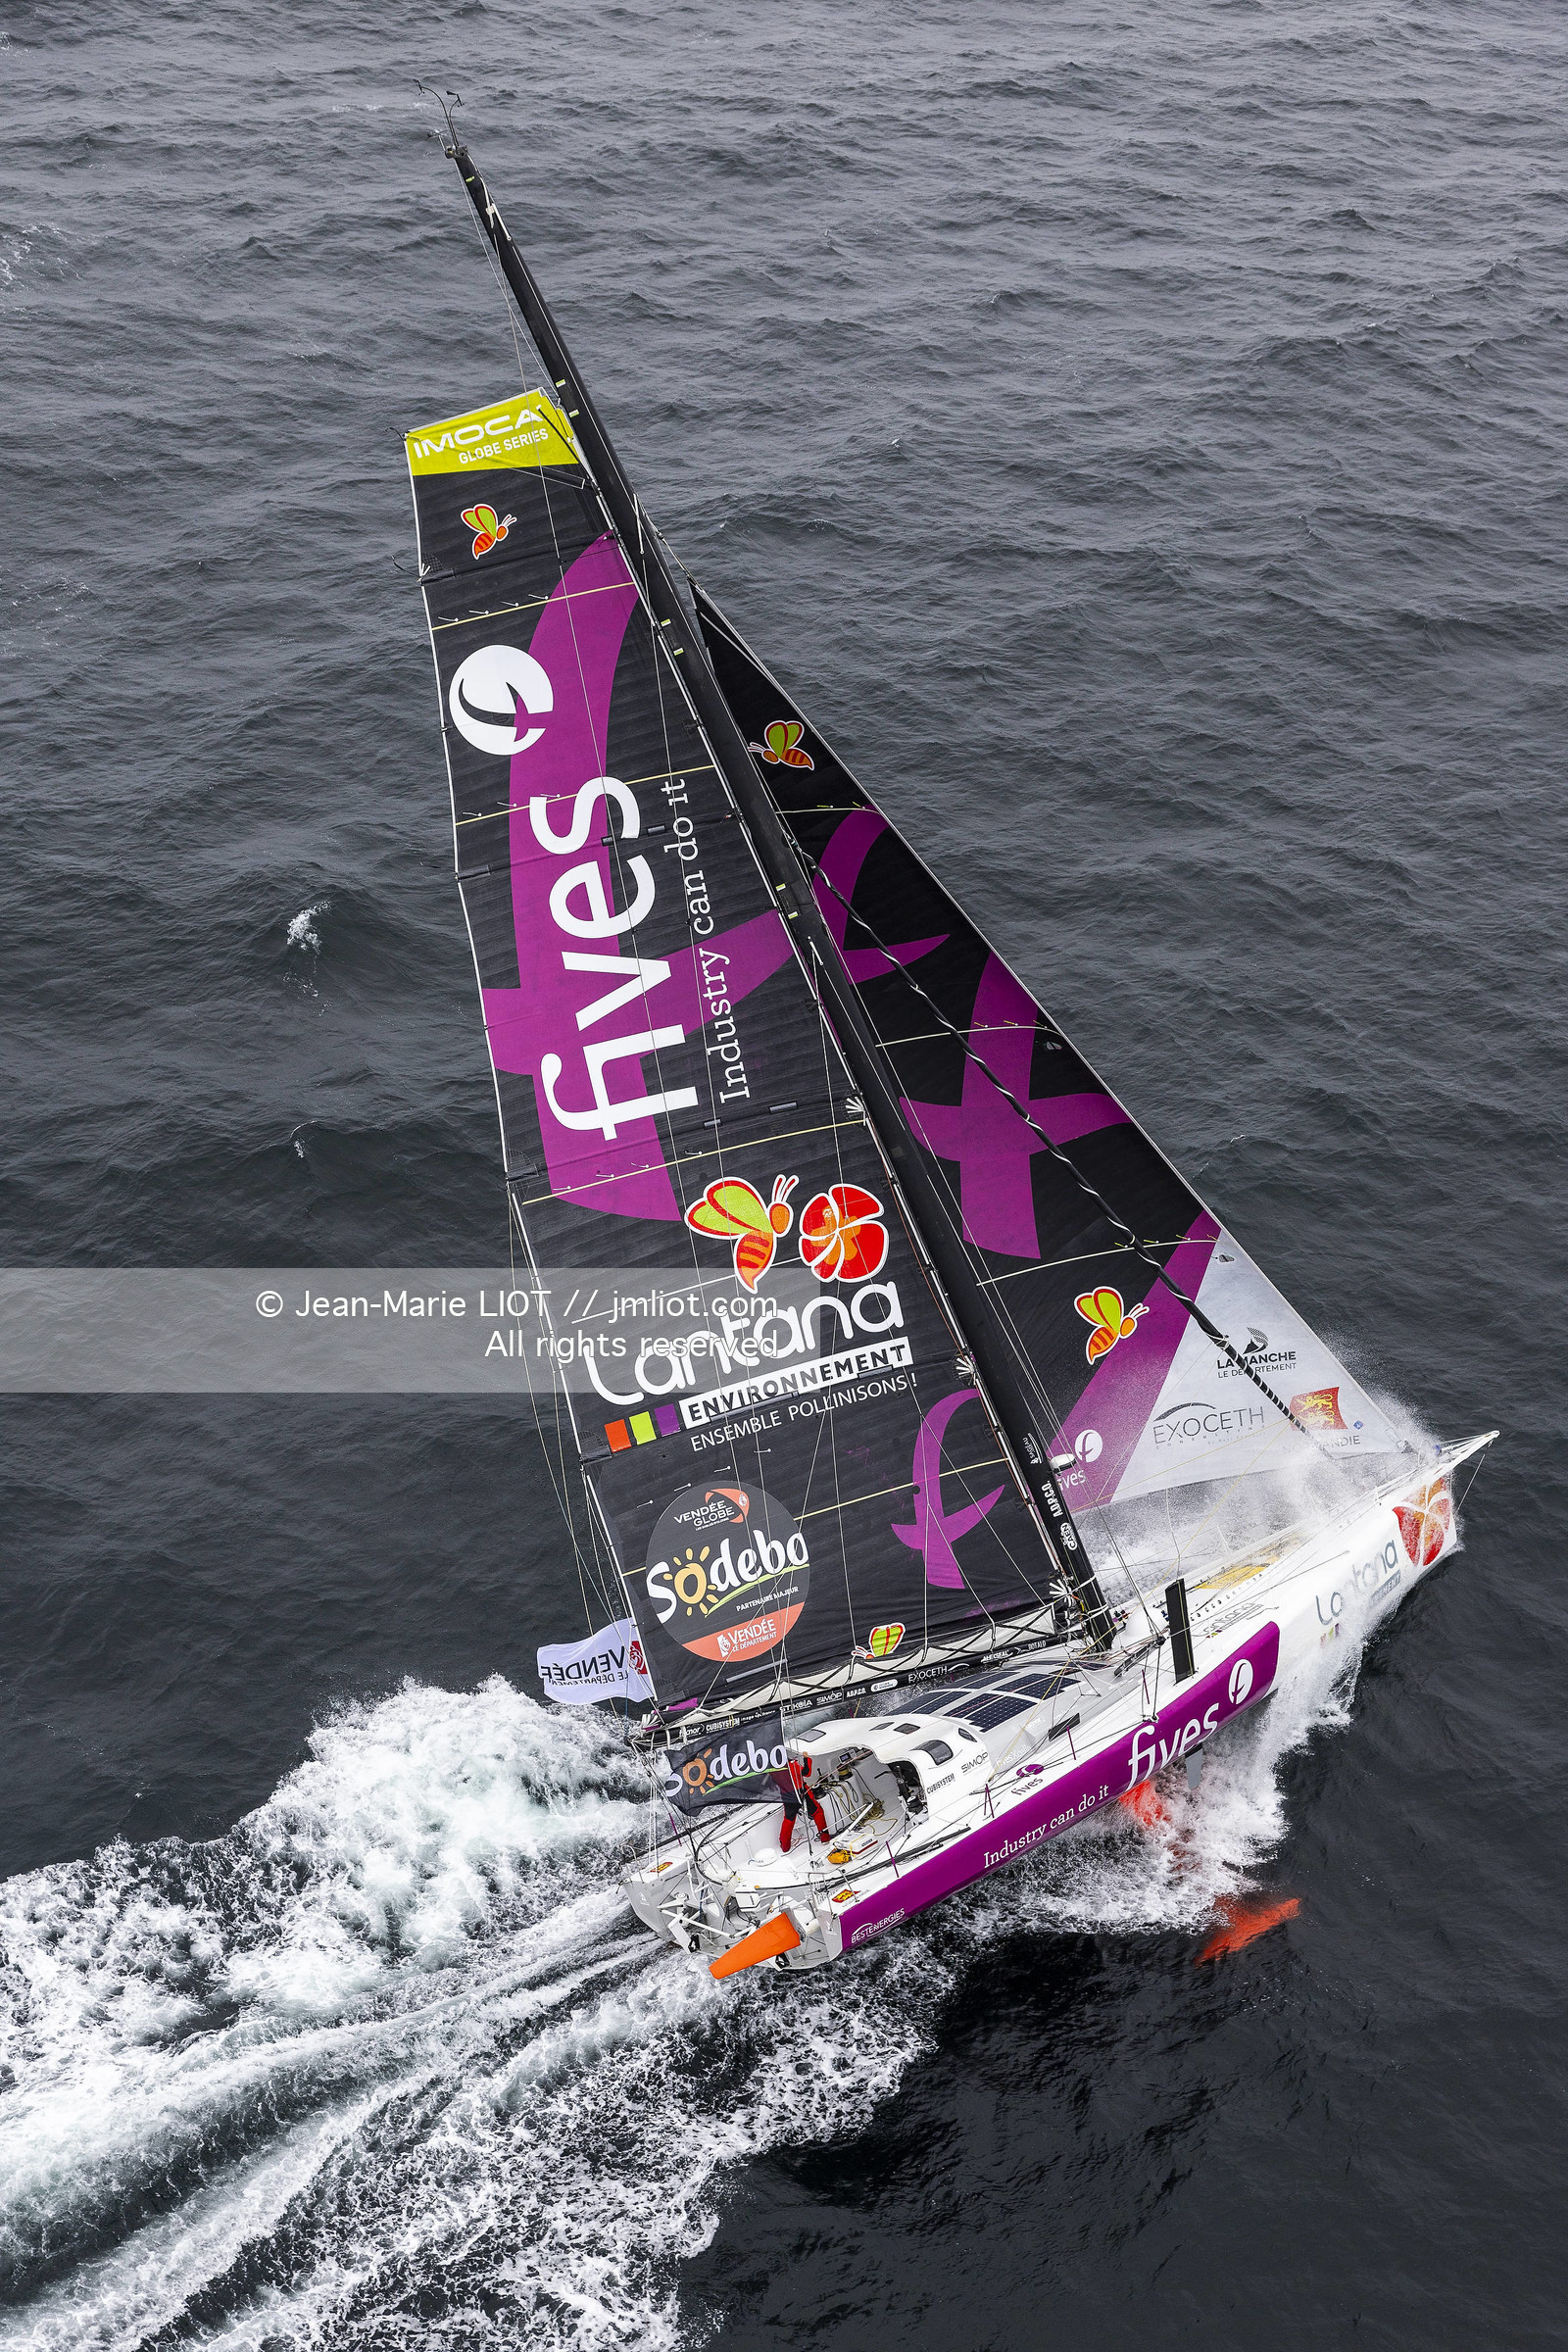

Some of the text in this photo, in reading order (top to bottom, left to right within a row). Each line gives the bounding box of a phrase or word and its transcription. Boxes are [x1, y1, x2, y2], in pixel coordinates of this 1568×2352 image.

[414, 409, 543, 459] IMOCA
[459, 428, 549, 465] GLOBE SERIES
[529, 776, 699, 1141] fives
[660, 778, 750, 1103] Industry can do it
[583, 1281, 905, 1405] Lantana
[1217, 1358, 1235, 1369] LA
[1231, 1362, 1297, 1377] DÉRTEMENT
[688, 1344, 906, 1422] ENVIRONNEMENT
[691, 1411, 782, 1451] ENSEMBLE
[788, 1379, 907, 1422] POLLINISONS
[1153, 1406, 1264, 1445] EXOCETH
[1058, 1470, 1087, 1492] ives
[673, 1500, 726, 1524] VENDÉE
[693, 1506, 735, 1526] GLOBE
[646, 1530, 809, 1624] Sodebo
[736, 1587, 800, 1612] PARTENAIRE MAJEUR
[728, 1618, 777, 1644] VENDÉE
[907, 1666, 948, 1683] EXOCETH
[961, 1751, 989, 1774] SIMOP
[1124, 1702, 1221, 1791] fives
[926, 1773, 956, 1794] CUBISYSTEM
[1010, 1778, 1044, 1796] fives
[983, 1784, 1109, 1869] Industry can do it
[851, 1907, 906, 1943] BESTENERGIES
